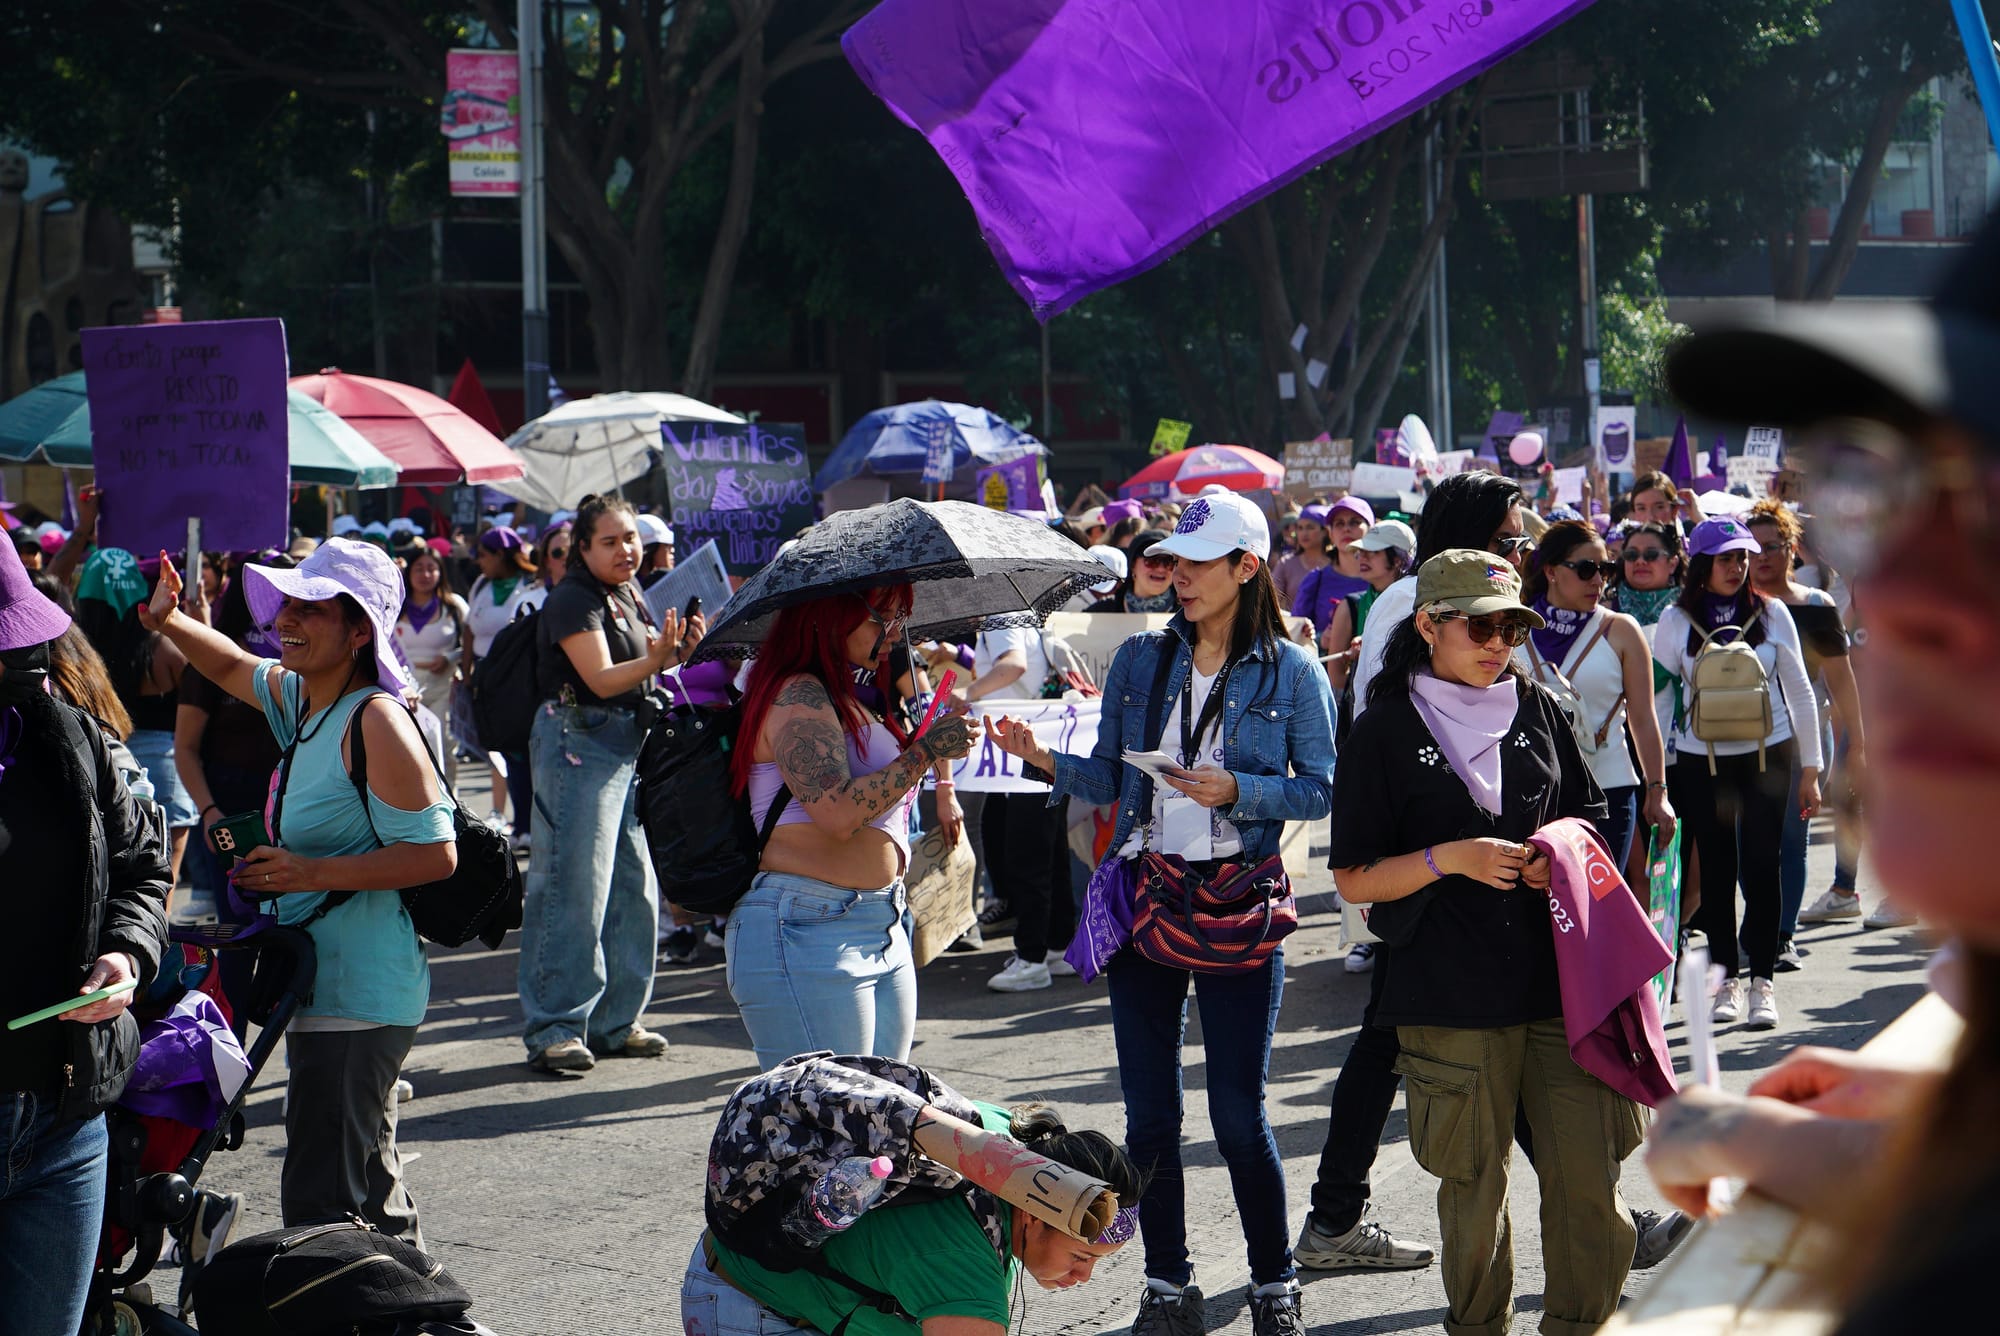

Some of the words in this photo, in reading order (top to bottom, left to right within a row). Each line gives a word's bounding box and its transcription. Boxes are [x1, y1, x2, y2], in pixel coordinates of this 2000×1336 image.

[165, 374, 239, 404] RESISTO
[660, 422, 804, 467] Valientes
[1546, 619, 1577, 635] #8M
